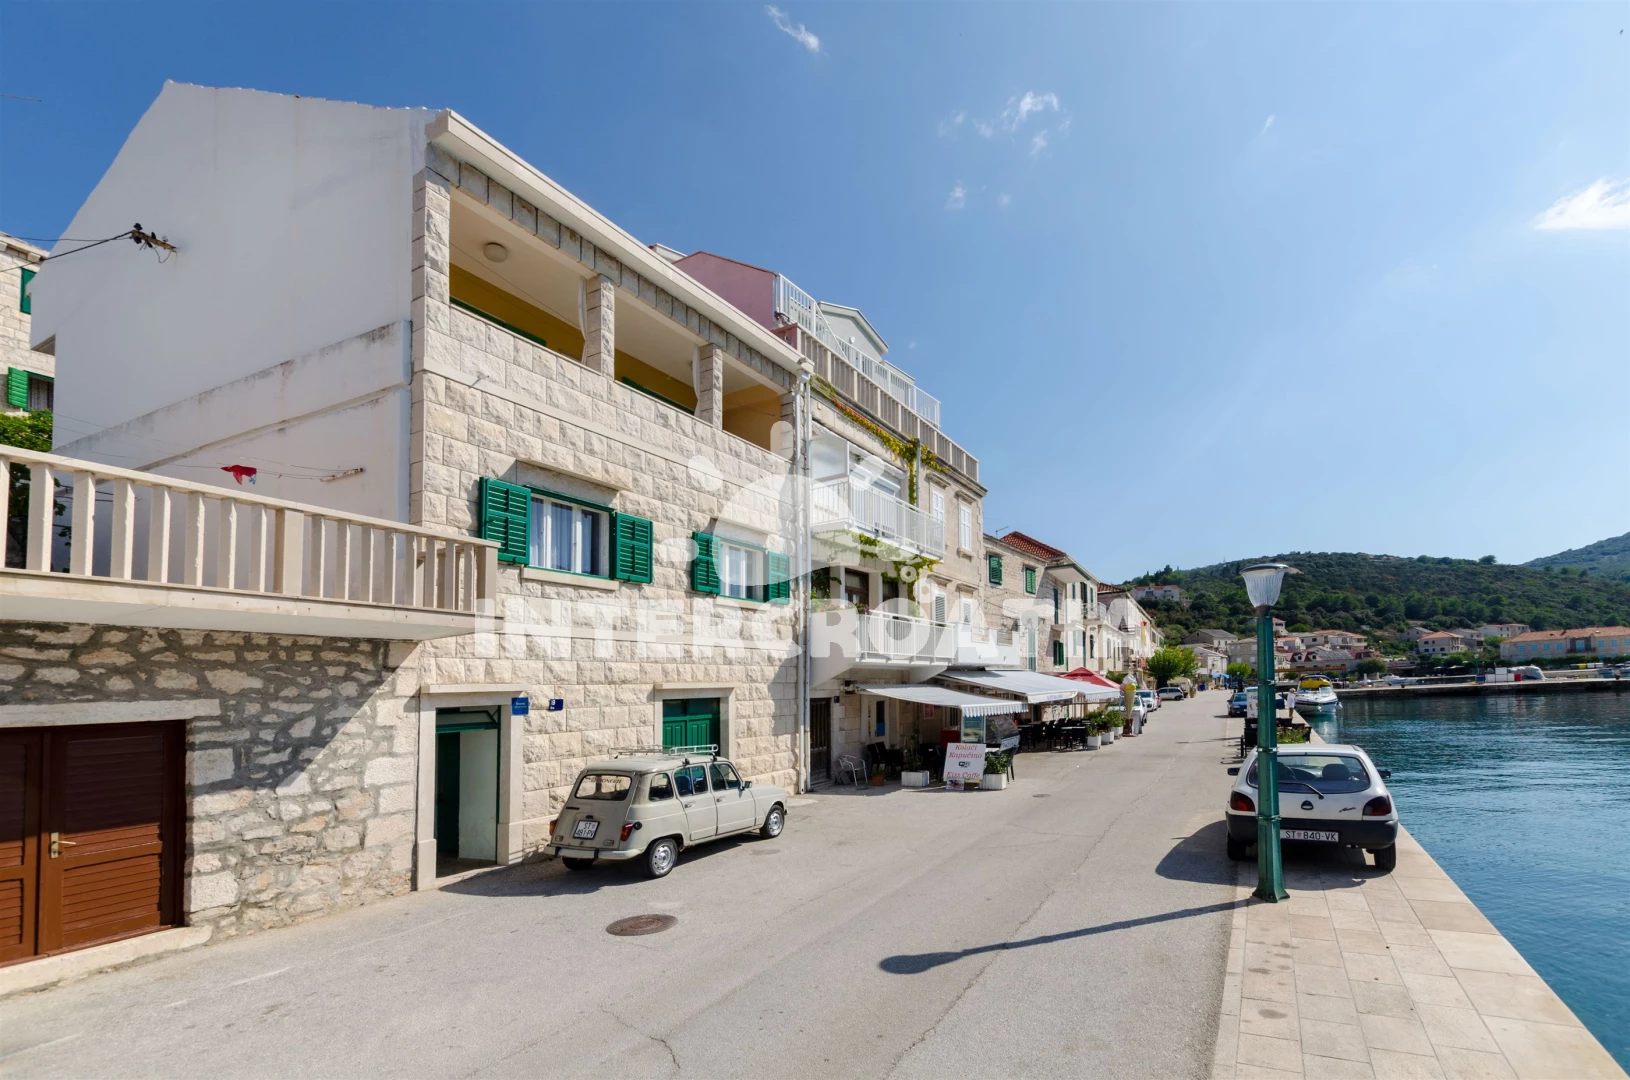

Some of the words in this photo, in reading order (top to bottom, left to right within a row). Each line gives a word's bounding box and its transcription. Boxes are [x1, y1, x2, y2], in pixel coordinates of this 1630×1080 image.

[583, 822, 592, 830] ST
[1285, 830, 1297, 839] ST
[1303, 831, 1337, 841] 840-VK
